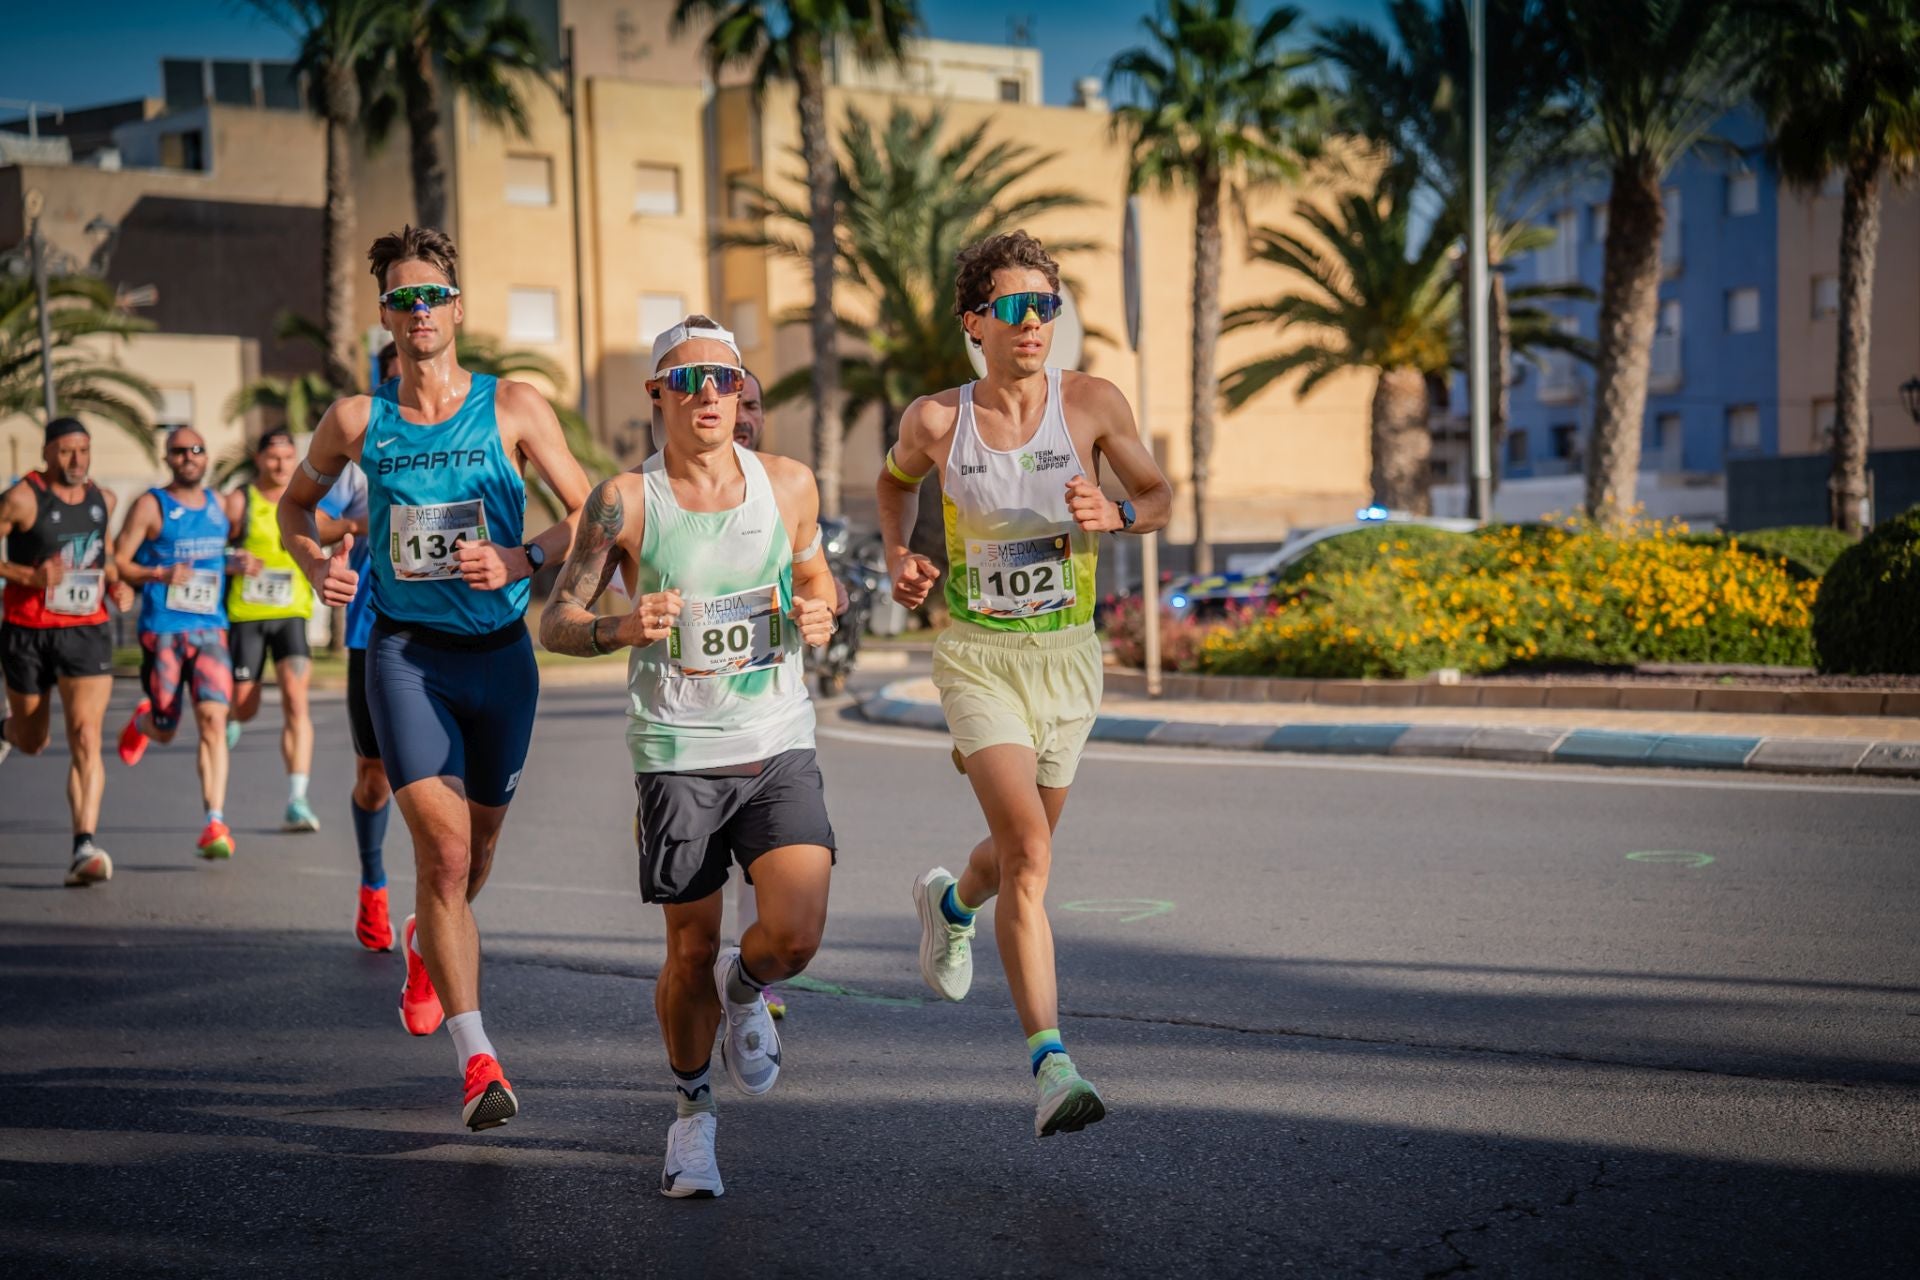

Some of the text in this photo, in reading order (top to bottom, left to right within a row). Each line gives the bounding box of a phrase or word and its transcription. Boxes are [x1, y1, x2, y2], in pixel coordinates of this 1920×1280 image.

[378, 449, 486, 475] SPARTA
[1034, 449, 1053, 459] TEAM
[1038, 454, 1071, 463] TRAINING
[1036, 461, 1068, 471] SUPPORT
[416, 507, 454, 520] MEDIA
[987, 543, 998, 562] VIII
[998, 541, 1038, 556] MEDIA
[988, 566, 1054, 597] 102
[67, 586, 89, 603] 10
[691, 602, 704, 621] VIII
[704, 596, 745, 614] MEDIA
[702, 624, 749, 656] 80
